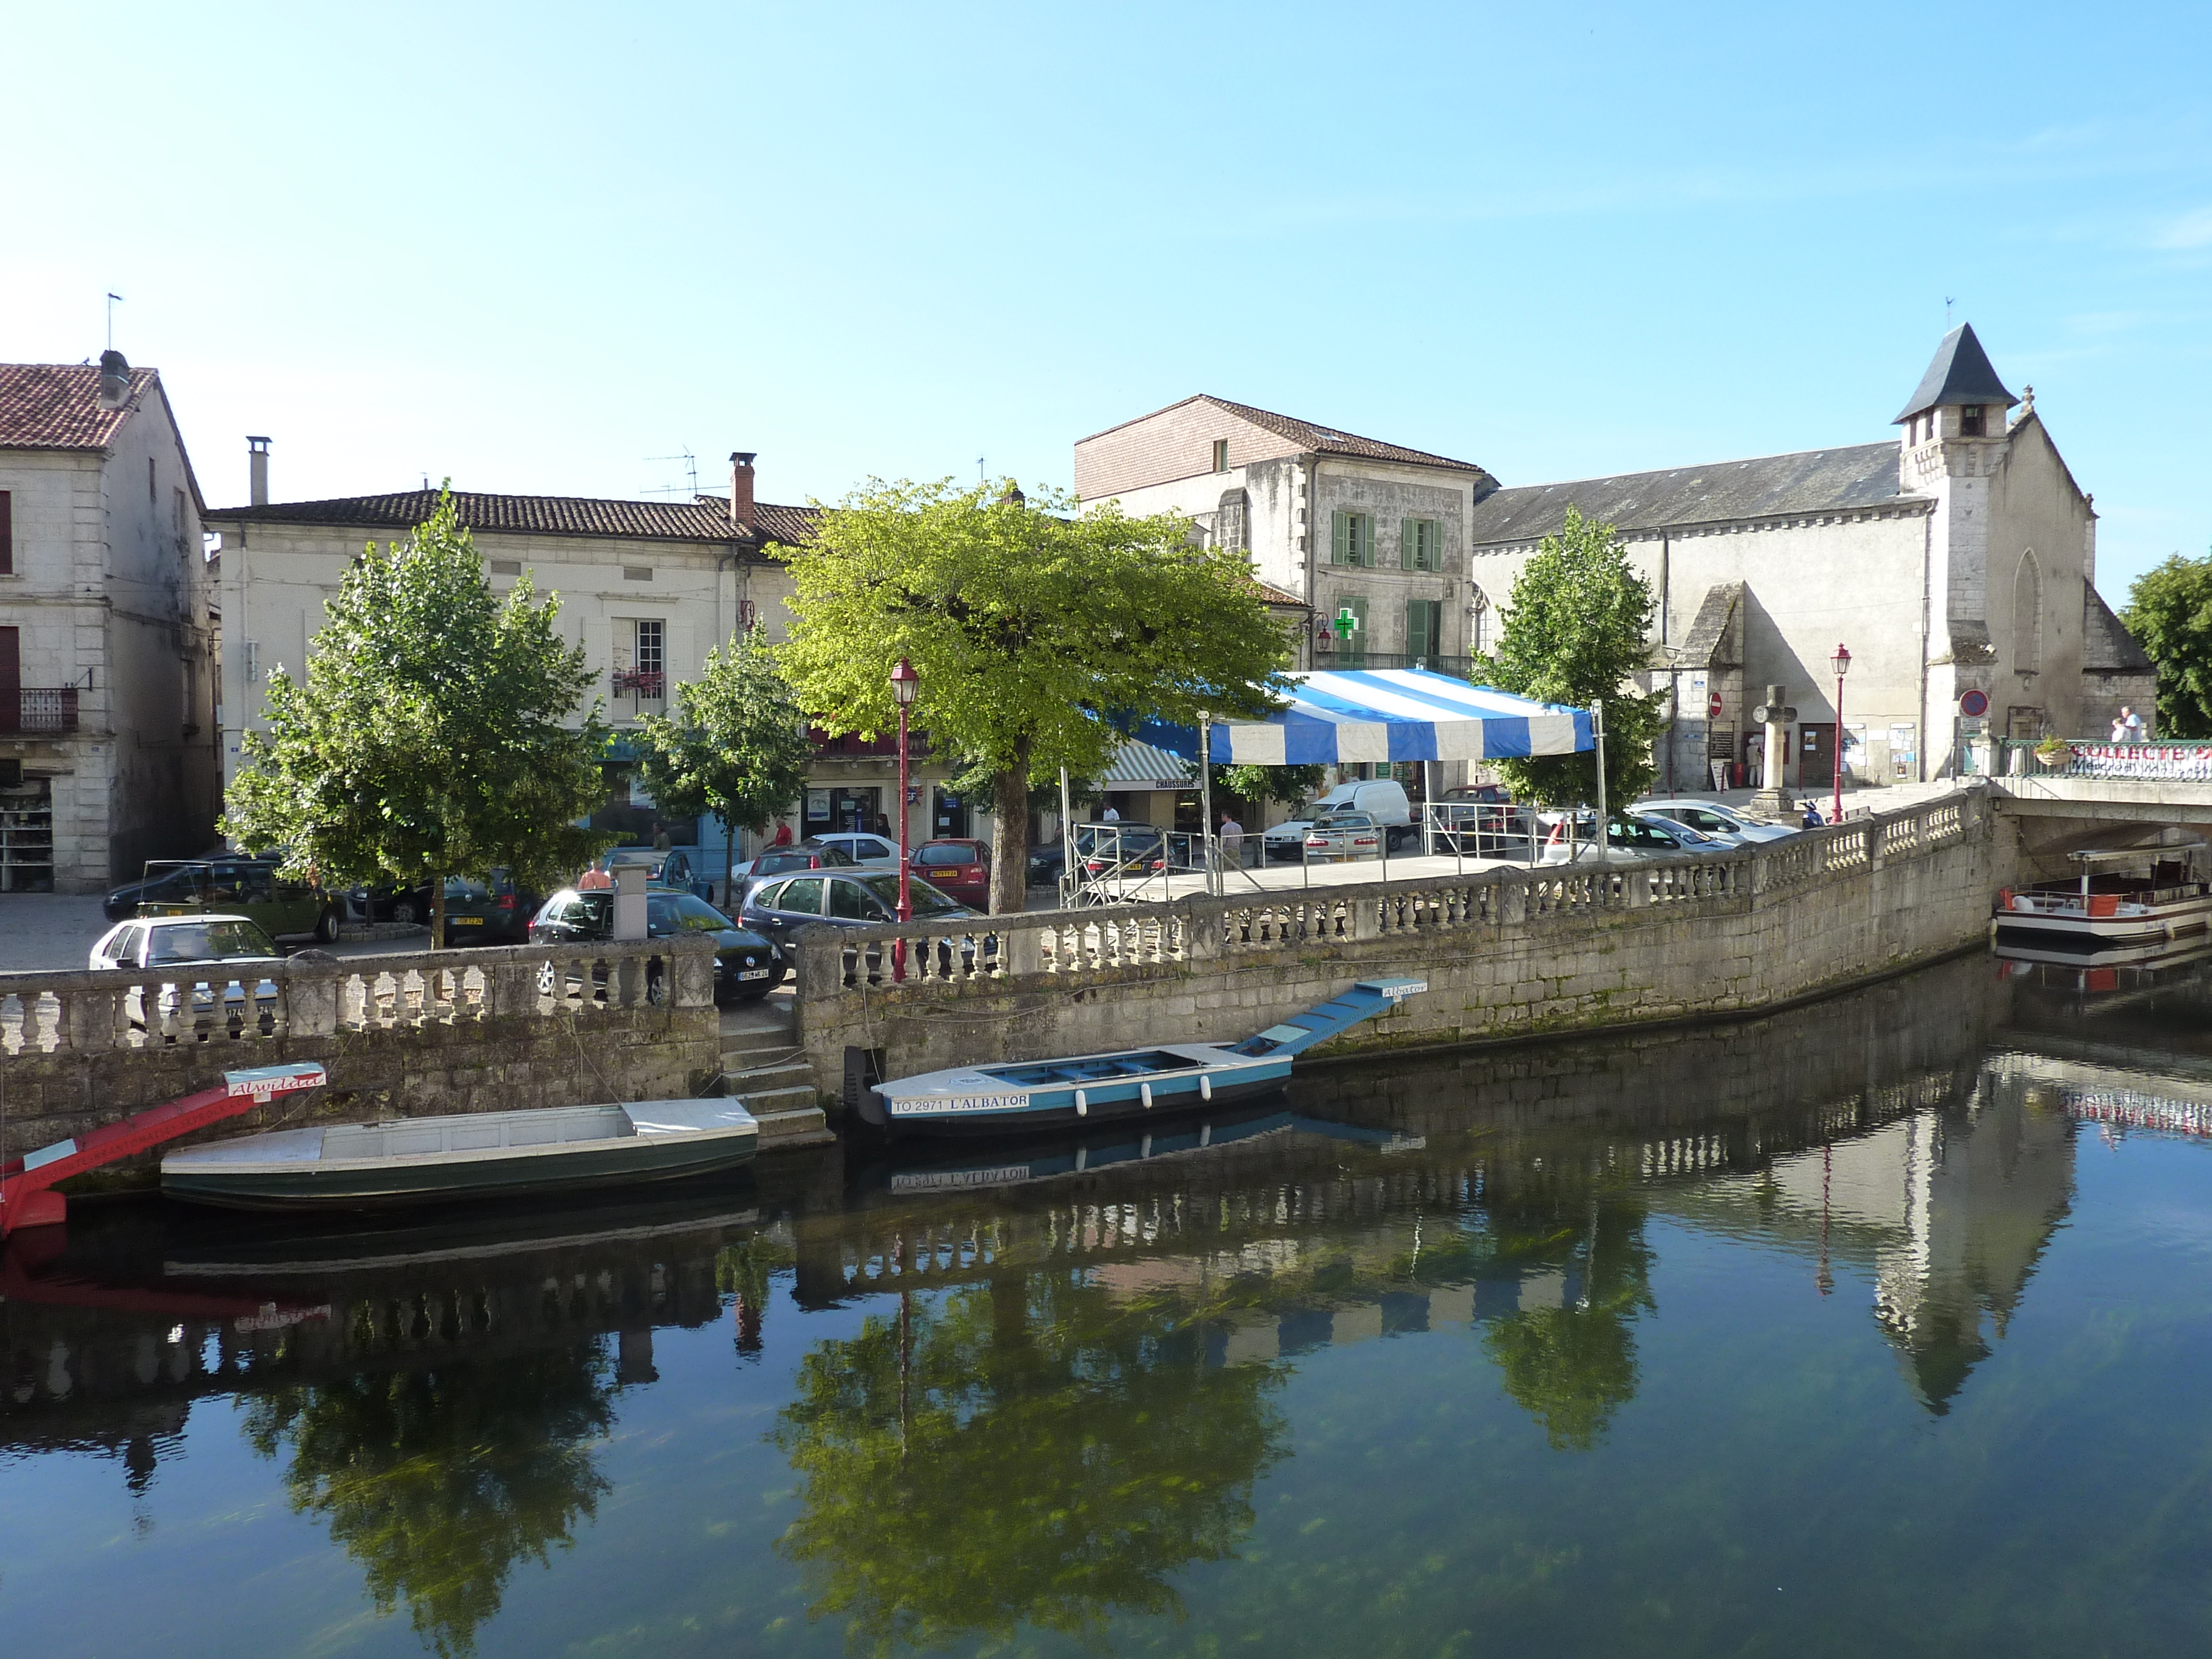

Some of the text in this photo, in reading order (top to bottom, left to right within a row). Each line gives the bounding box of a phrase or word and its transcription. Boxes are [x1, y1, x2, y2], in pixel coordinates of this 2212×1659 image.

[1156, 780, 1195, 789] CHAUSSURES
[907, 792, 916, 801] GF
[1384, 985, 1426, 997] Albator
[228, 1008, 244, 1017] 174
[896, 1095, 1027, 1112] TO 2971 L'ALBATOR
